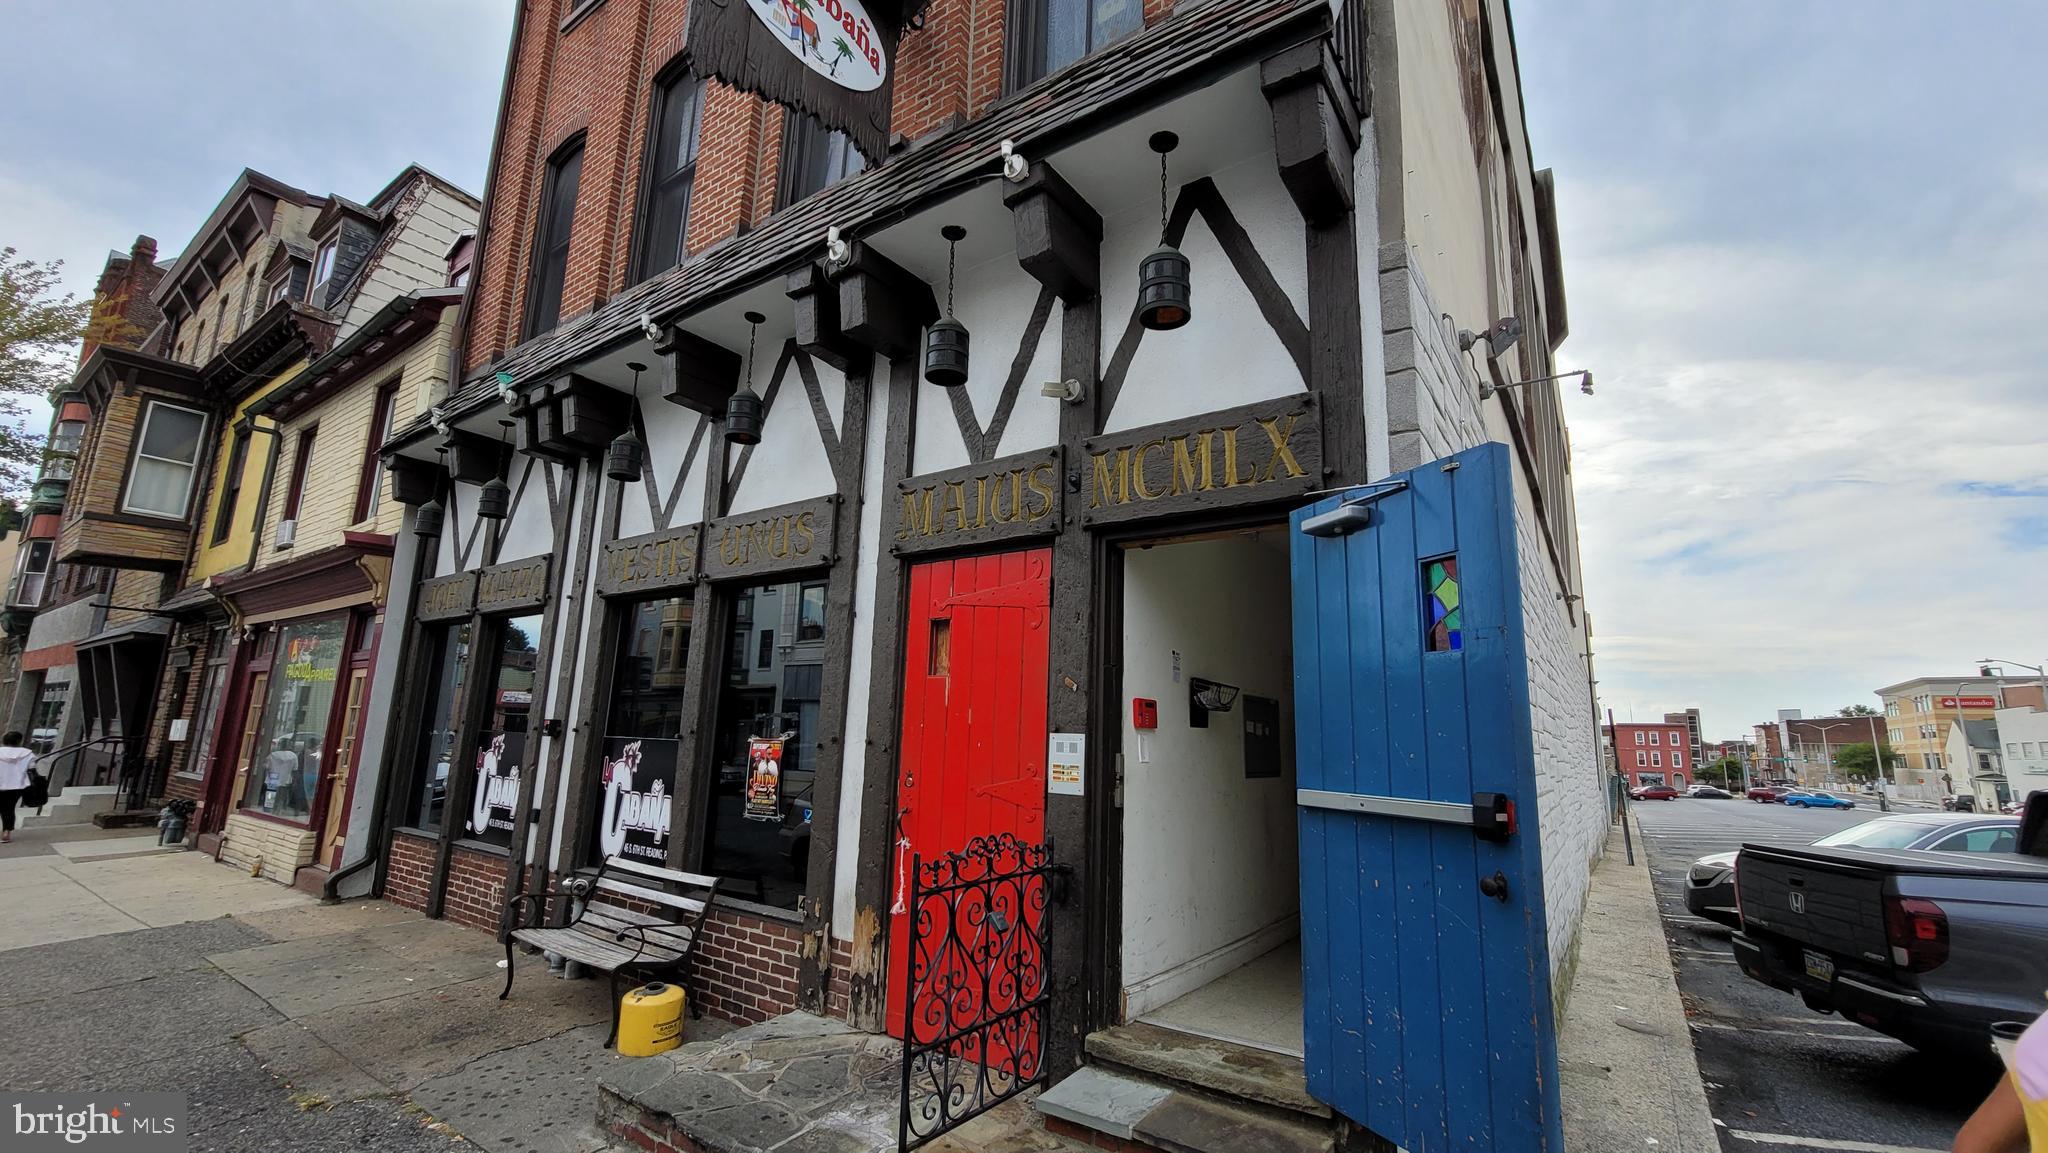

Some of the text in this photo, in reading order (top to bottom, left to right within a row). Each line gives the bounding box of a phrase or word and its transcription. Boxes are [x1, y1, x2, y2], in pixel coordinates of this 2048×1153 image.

[818, 0, 880, 76] baña
[899, 411, 1310, 540] MAIUS MCMLX
[720, 509, 816, 567] UNUS
